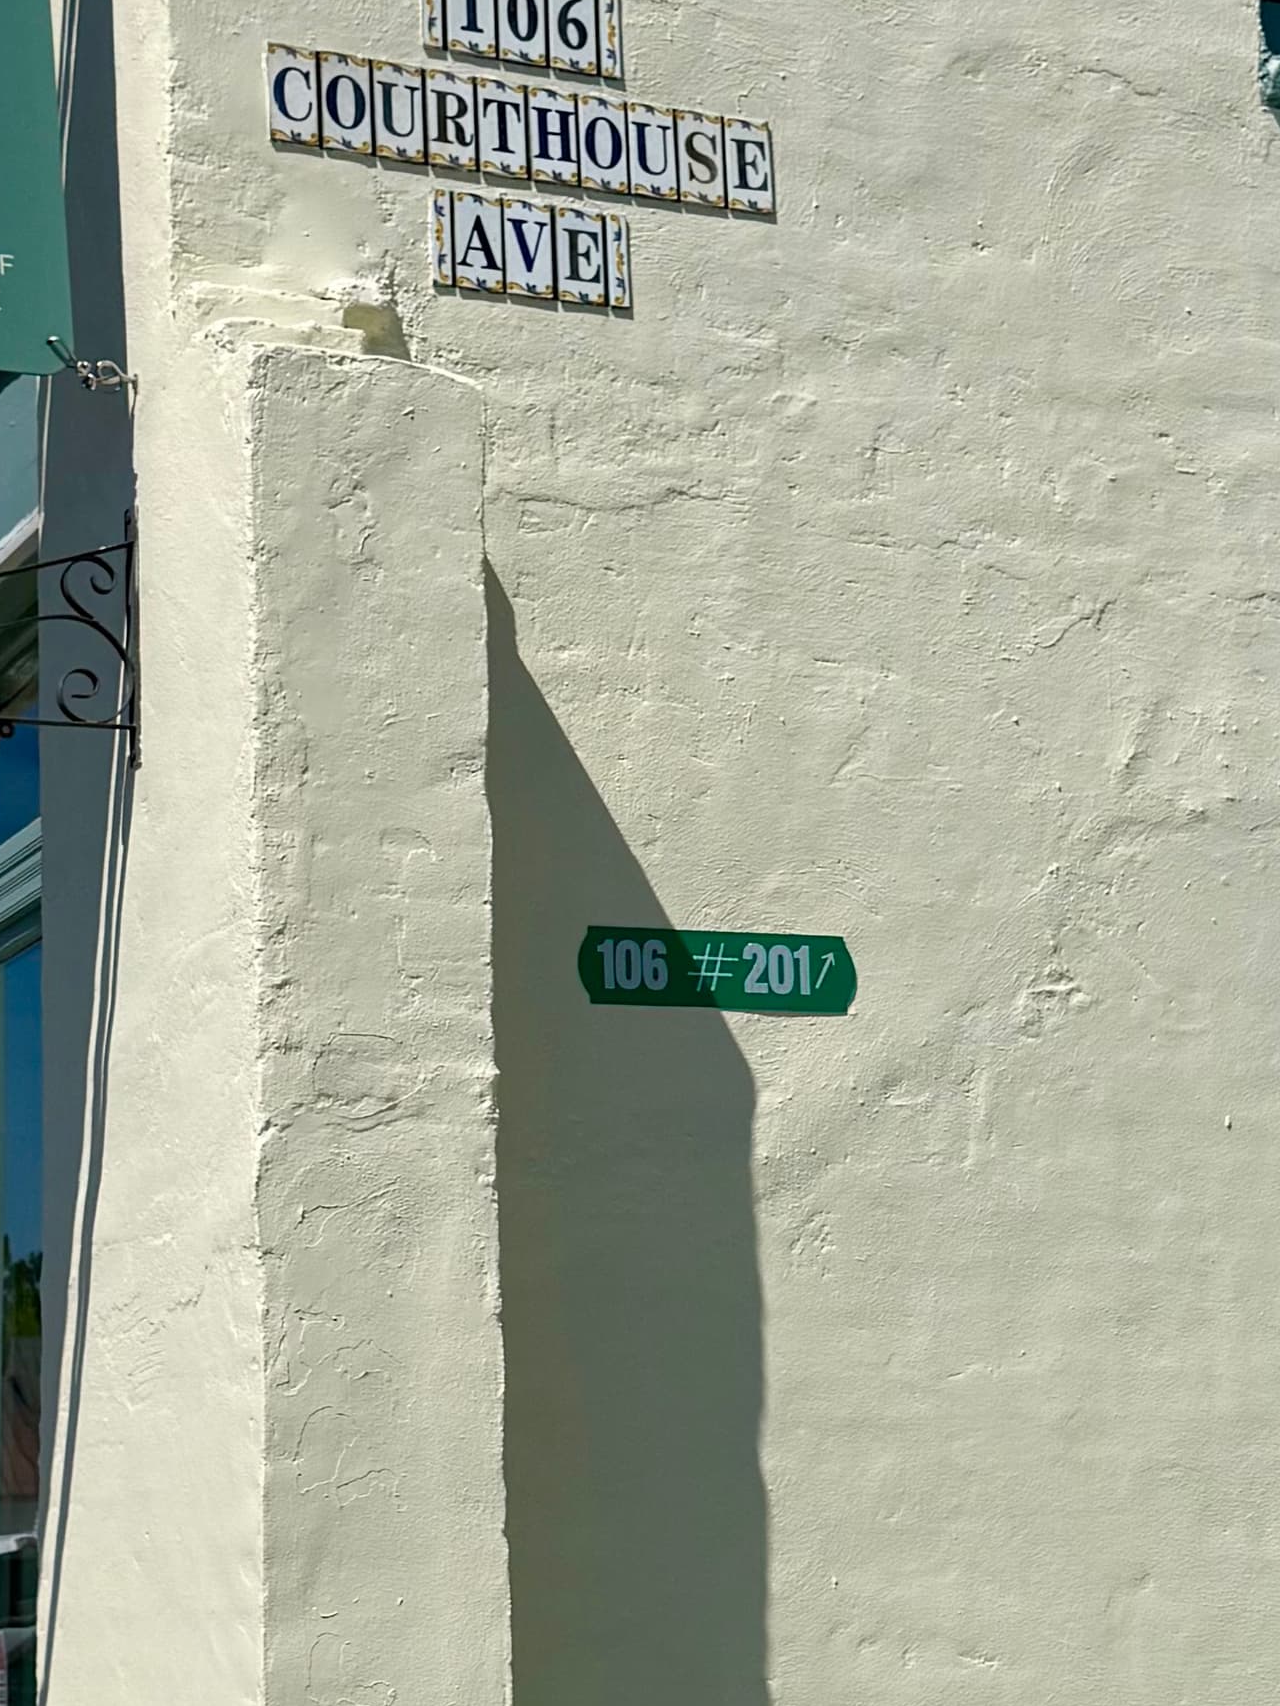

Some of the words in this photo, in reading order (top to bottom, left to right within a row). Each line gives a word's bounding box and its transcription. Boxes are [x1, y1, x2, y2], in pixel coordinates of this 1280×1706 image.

[272, 65, 770, 192] COURTHOUSE
[456, 213, 602, 285] AVE
[596, 938, 669, 991] 106
